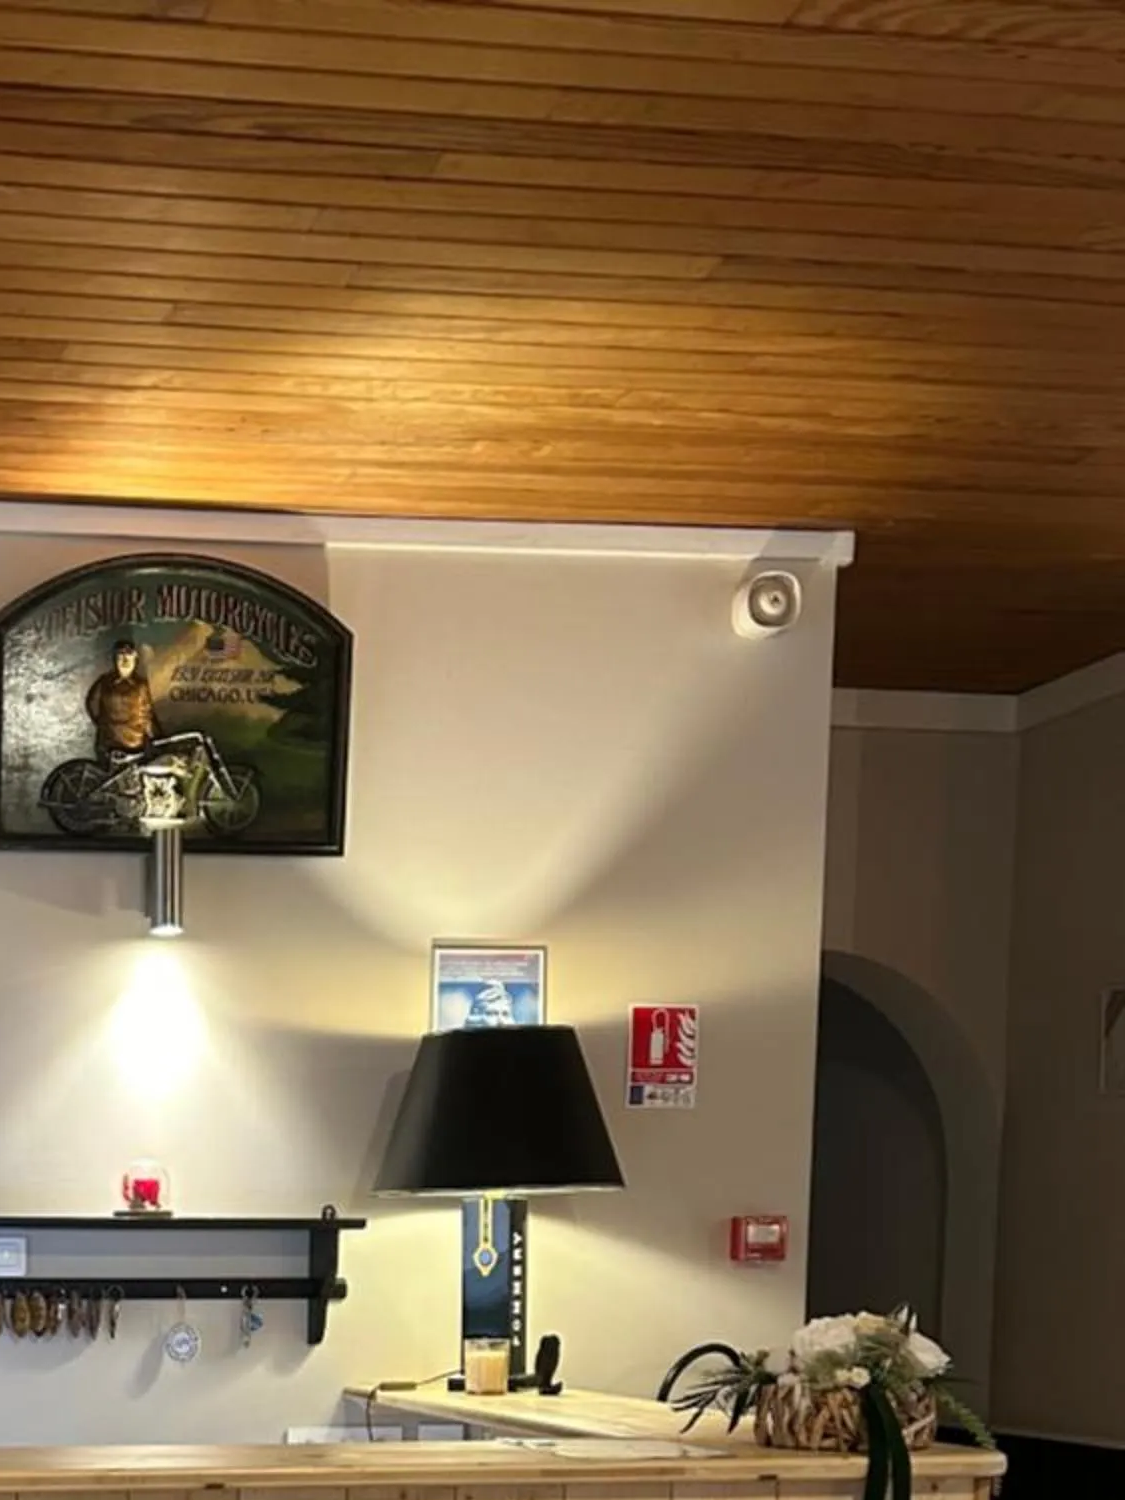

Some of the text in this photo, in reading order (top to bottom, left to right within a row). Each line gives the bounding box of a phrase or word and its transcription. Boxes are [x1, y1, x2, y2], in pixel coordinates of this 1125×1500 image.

[19, 584, 318, 667] XCELSIOR MOTORCYCLES
[511, 1231, 523, 1347] POMMERY
